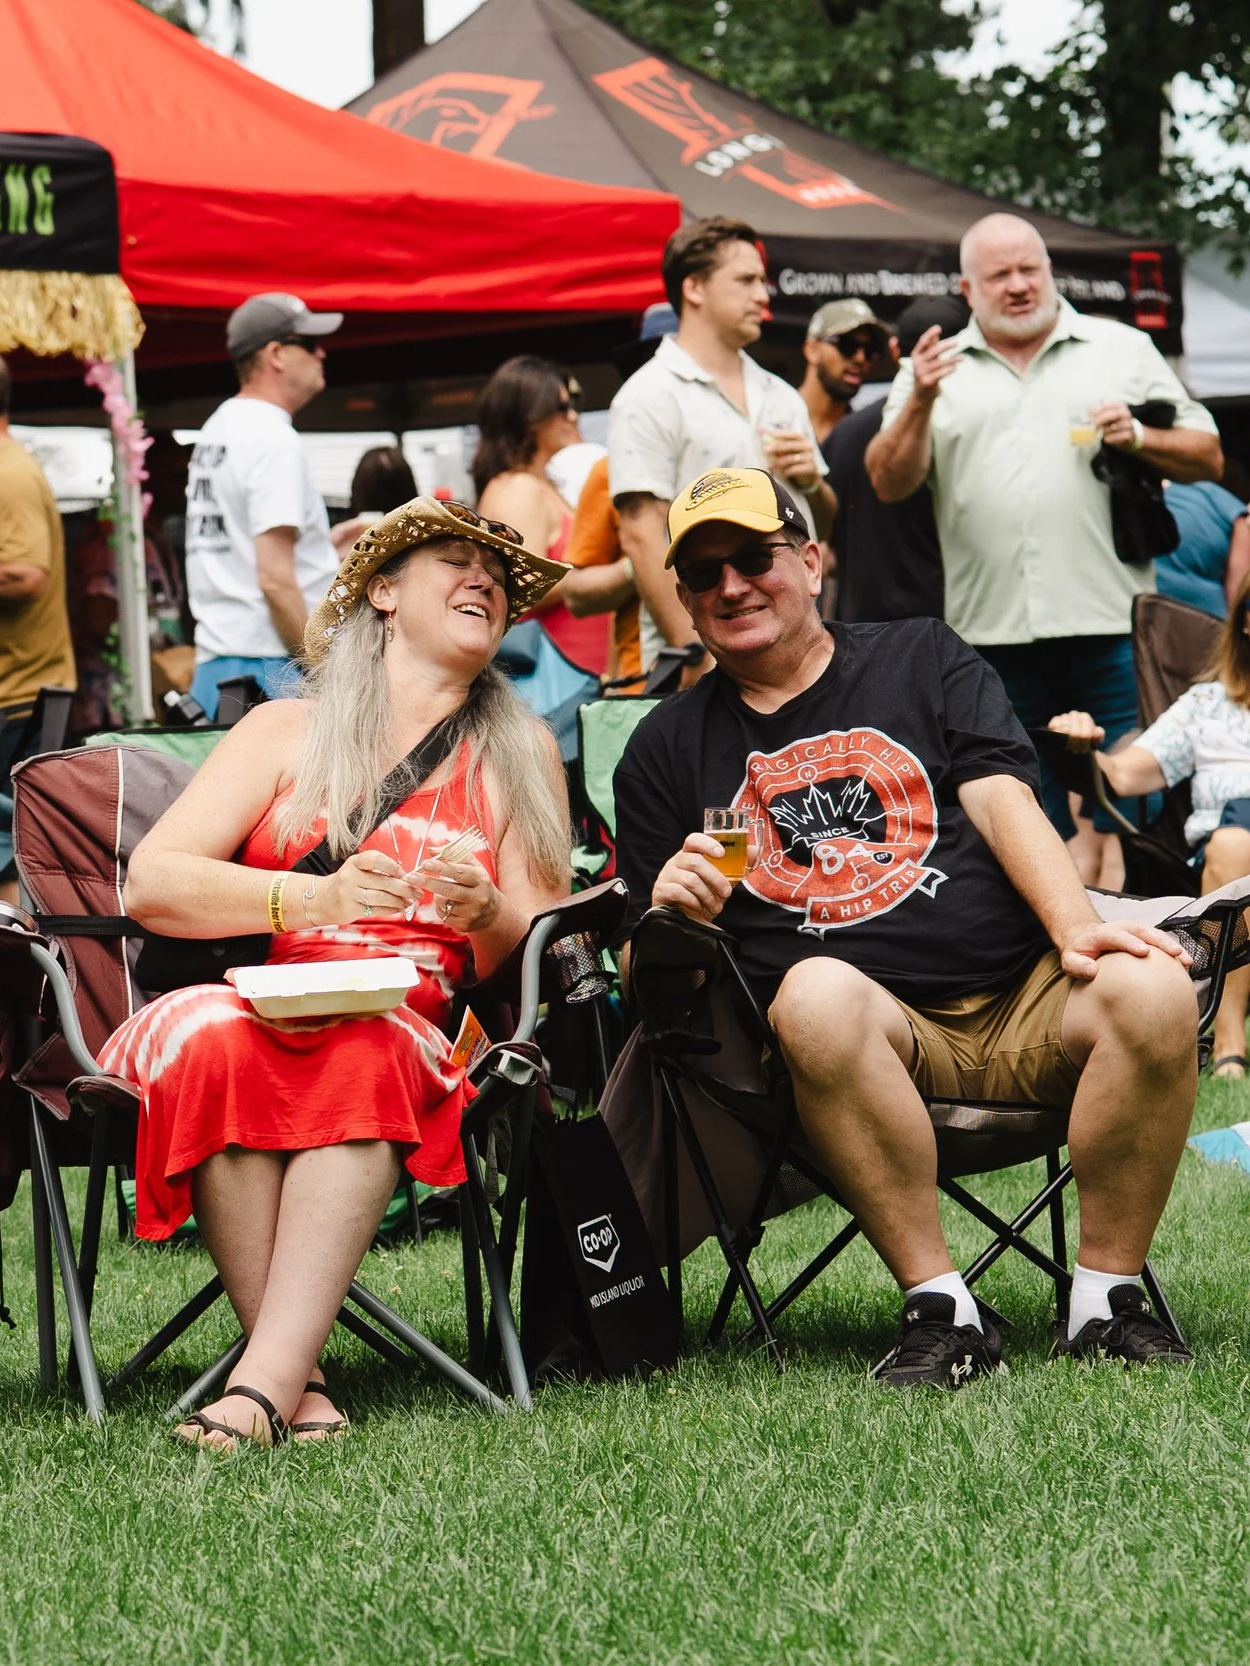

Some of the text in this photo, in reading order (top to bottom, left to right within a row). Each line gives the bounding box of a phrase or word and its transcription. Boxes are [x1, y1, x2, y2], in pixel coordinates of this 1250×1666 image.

[694, 132, 787, 178] LONG
[750, 735, 871, 777] RAGICALLY
[810, 826, 850, 838] SINCE
[820, 870, 916, 919] A HIP TRIP
[271, 907, 280, 920] Beer
[598, 1285, 620, 1305] ISLAND
[619, 1275, 645, 1296] LIQUOR
